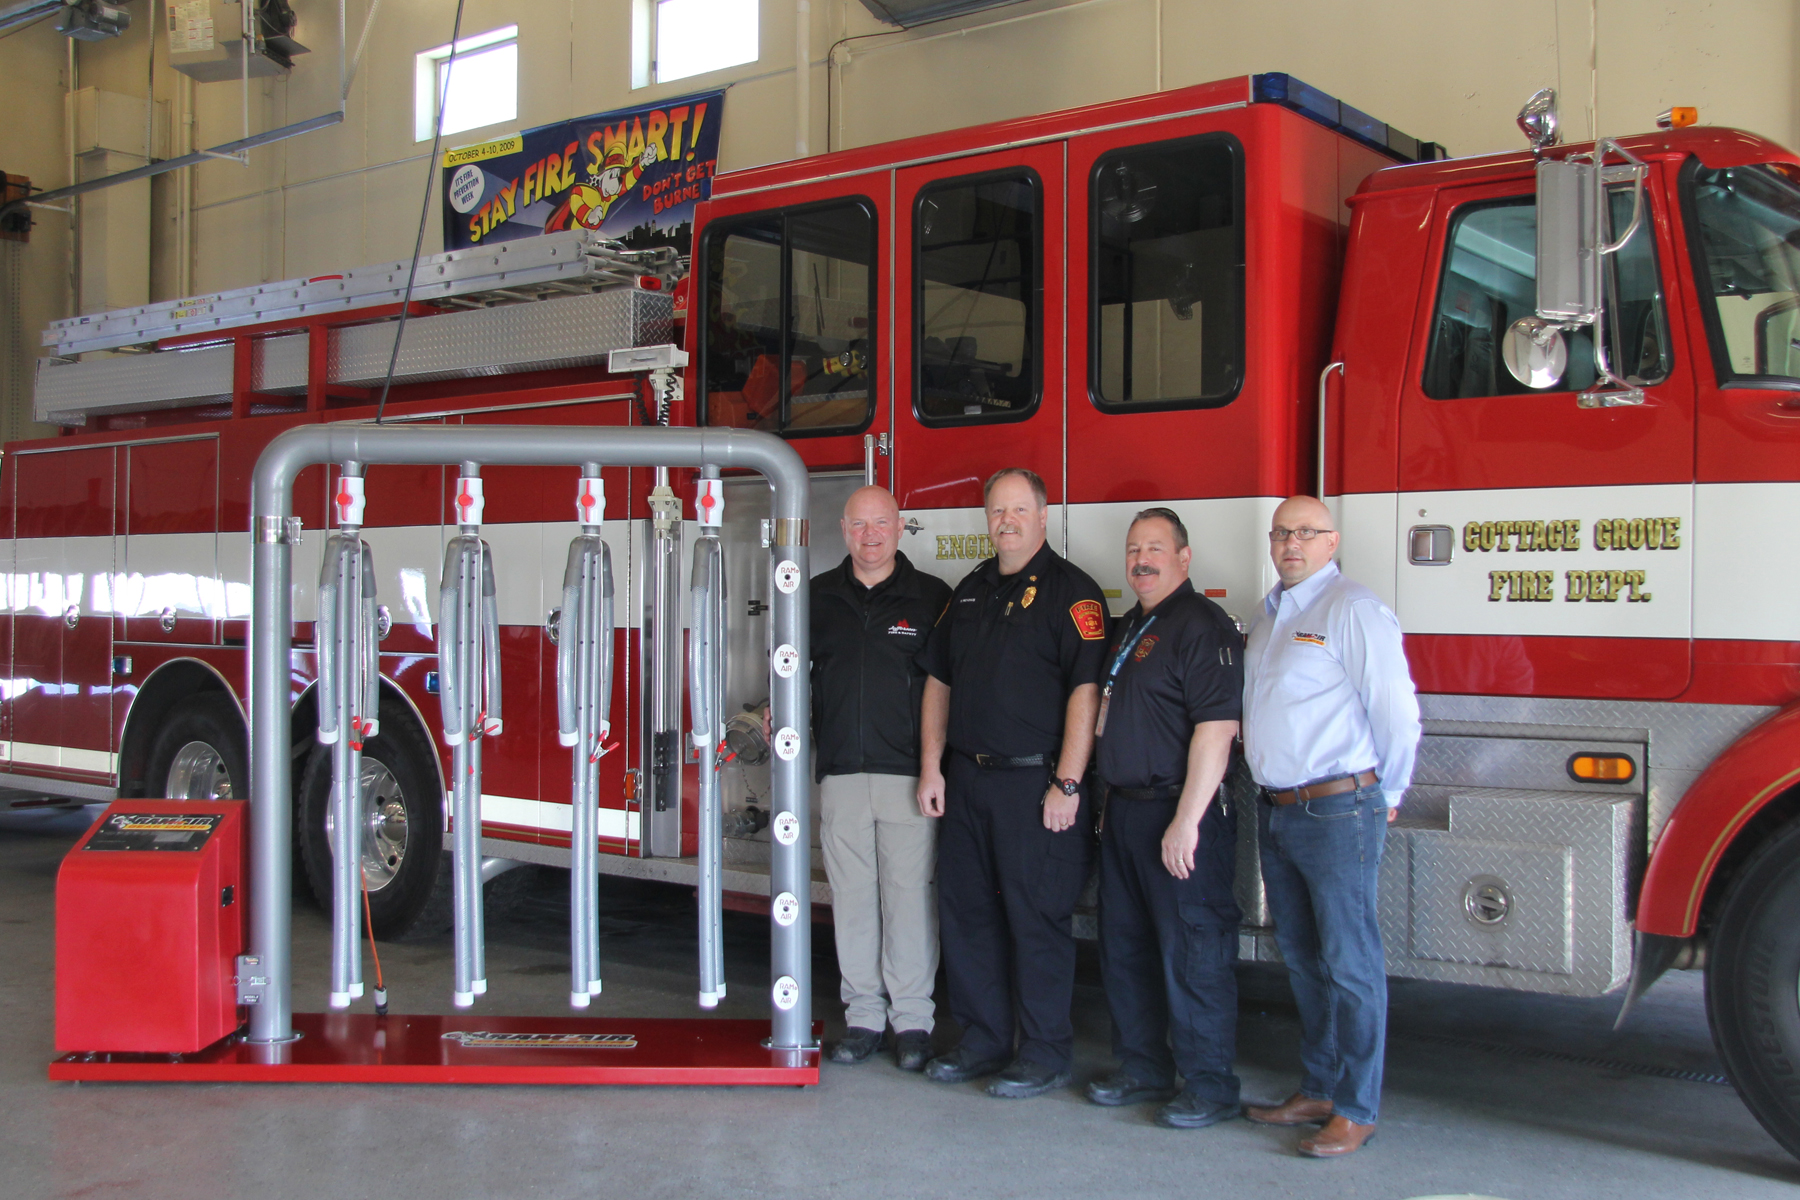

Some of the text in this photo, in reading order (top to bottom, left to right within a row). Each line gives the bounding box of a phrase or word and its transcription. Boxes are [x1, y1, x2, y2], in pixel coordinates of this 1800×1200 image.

[449, 149, 479, 162] OCTOBER
[500, 141, 515, 152] 2009
[455, 169, 474, 187] IT'S FIRE
[469, 103, 708, 243] STAY FIRE SMART!
[643, 159, 717, 202] DON'T GET
[454, 176, 480, 200] PREVENTION
[461, 191, 475, 205] WEEK
[653, 183, 700, 215] BURNE
[936, 533, 998, 560] ENGIN
[1463, 517, 1681, 552] COTTAGE GROVE
[783, 580, 795, 588] AIR
[1488, 570, 1652, 603] FIRE DEPT.
[1076, 604, 1098, 613] FIRE
[783, 747, 795, 755] AIR
